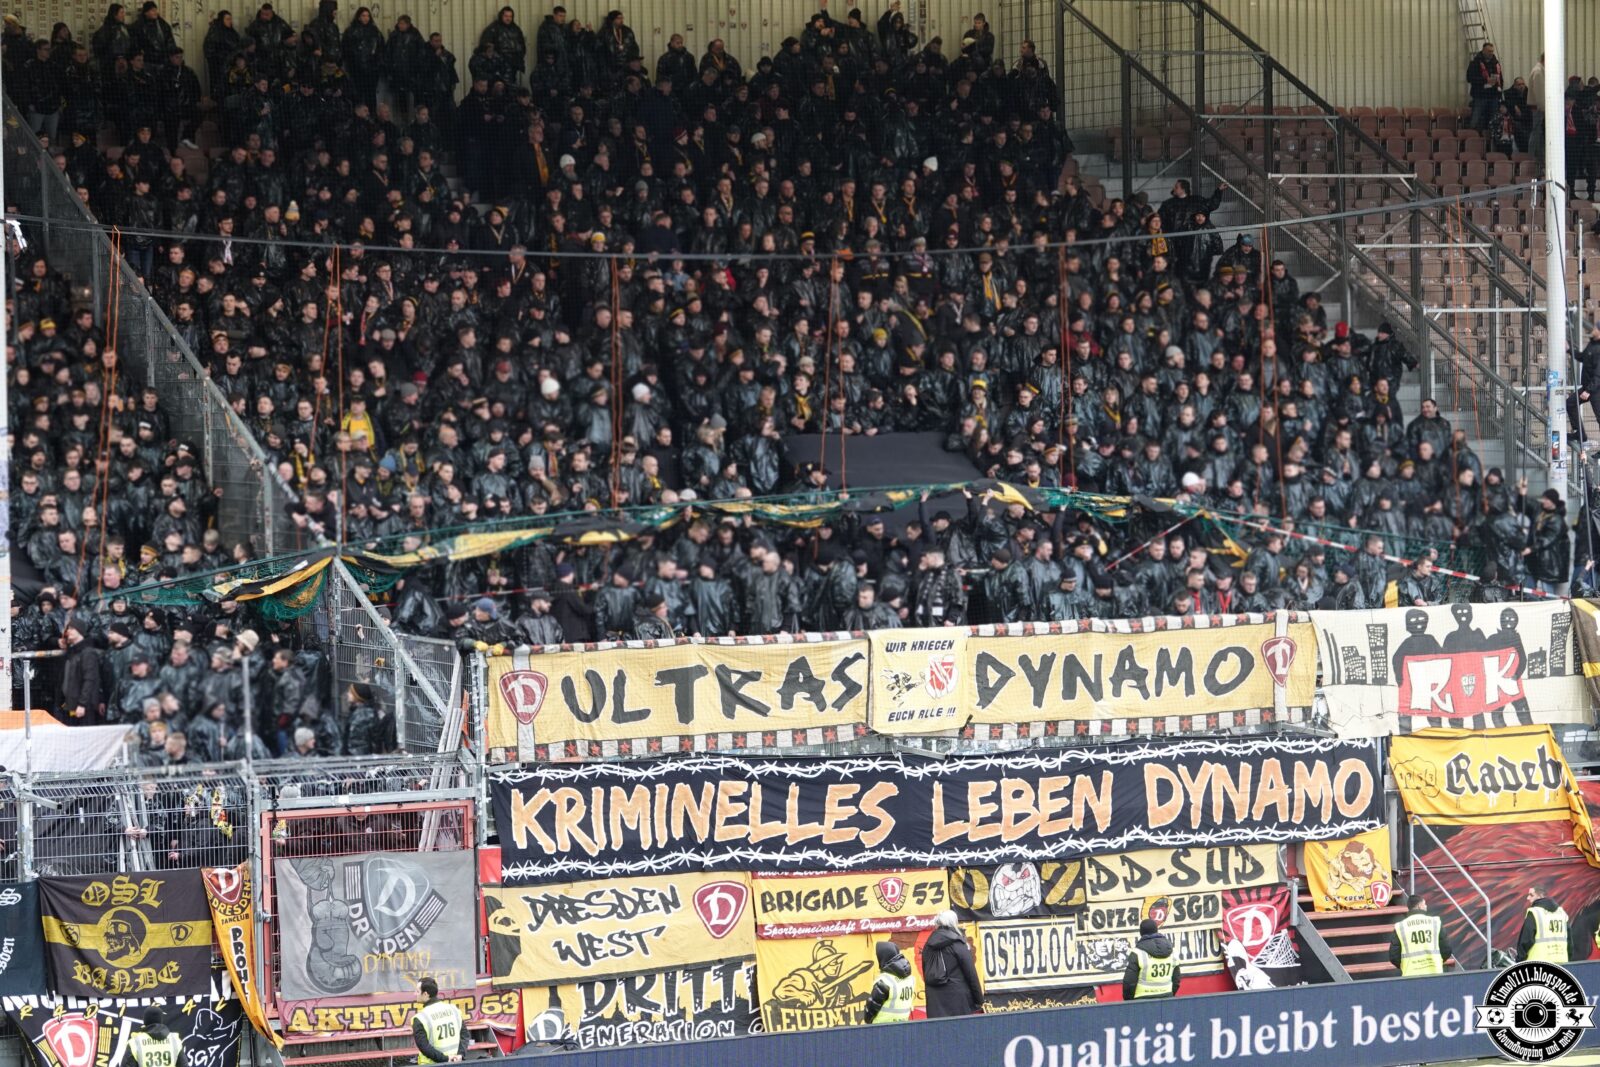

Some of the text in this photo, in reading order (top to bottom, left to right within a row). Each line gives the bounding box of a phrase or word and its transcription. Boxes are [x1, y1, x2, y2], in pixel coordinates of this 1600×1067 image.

[885, 640, 955, 653] WIR KRIEGEN
[561, 652, 866, 725] ULTRAS
[976, 644, 1255, 708] DYNAMO
[888, 710, 915, 722] EUCH
[918, 708, 943, 719] ALLE
[511, 758, 1373, 857] KRIMINELLES LEBEN DYNAMO
[81, 875, 165, 908] OSL
[212, 882, 252, 916] DRESDEN
[522, 885, 682, 932] DRESDEN
[760, 880, 945, 914] BRIGADE 53
[878, 896, 907, 913] DRESDEN
[348, 902, 422, 956] DRESDEN
[763, 921, 857, 938] Sportgemeinschaft
[860, 917, 902, 932] Dynamo
[1076, 894, 1220, 931] Forza SGD
[552, 925, 667, 967] WEST
[984, 926, 1090, 977] OSTBLOCK
[1411, 929, 1432, 945] 403
[72, 960, 182, 994] BANDE
[1151, 963, 1171, 978] 337
[287, 991, 520, 1032] AKTIVT 53
[437, 1022, 455, 1041] 276
[1003, 1021, 1196, 1067] Qualität
[1210, 1010, 1338, 1060] bleibt
[145, 1051, 172, 1067] 339
